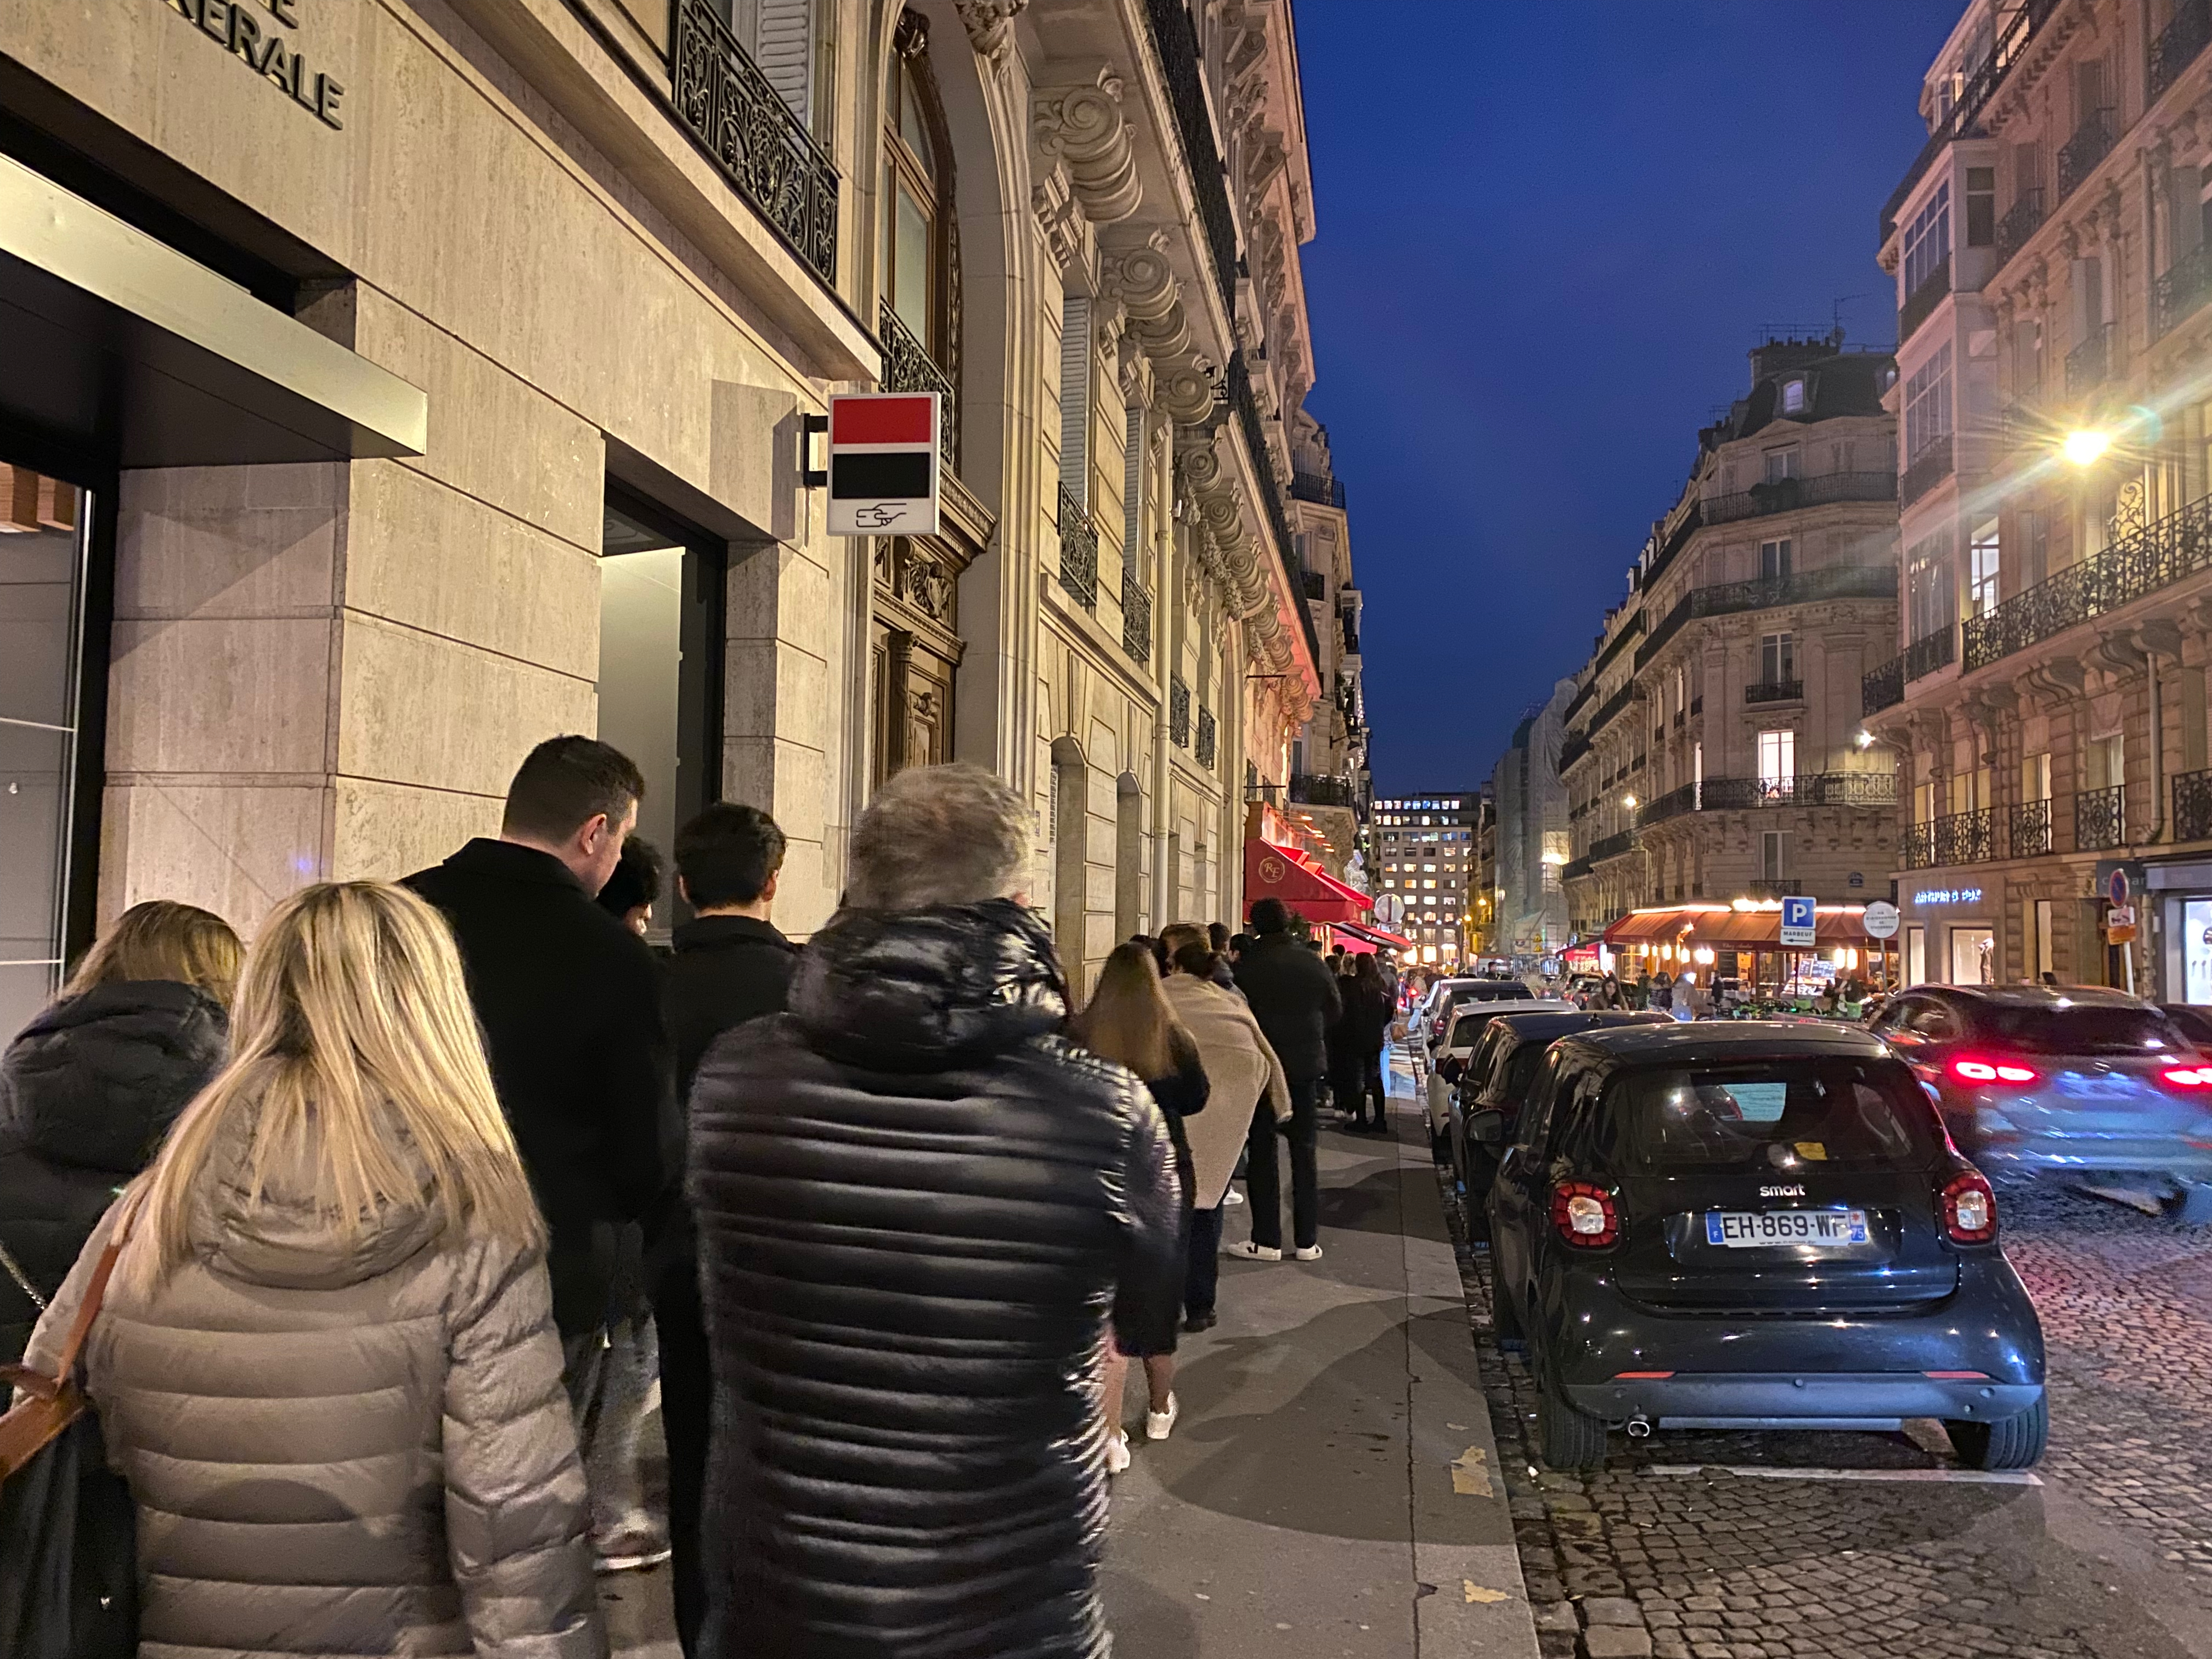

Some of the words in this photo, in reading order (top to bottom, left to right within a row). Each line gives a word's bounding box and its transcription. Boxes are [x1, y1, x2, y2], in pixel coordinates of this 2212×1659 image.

[1792, 903, 1807, 923] P
[1759, 1183, 1805, 1197] smart
[1722, 1215, 1846, 1239] EH-869-WF
[1852, 1227, 1864, 1239] 75
